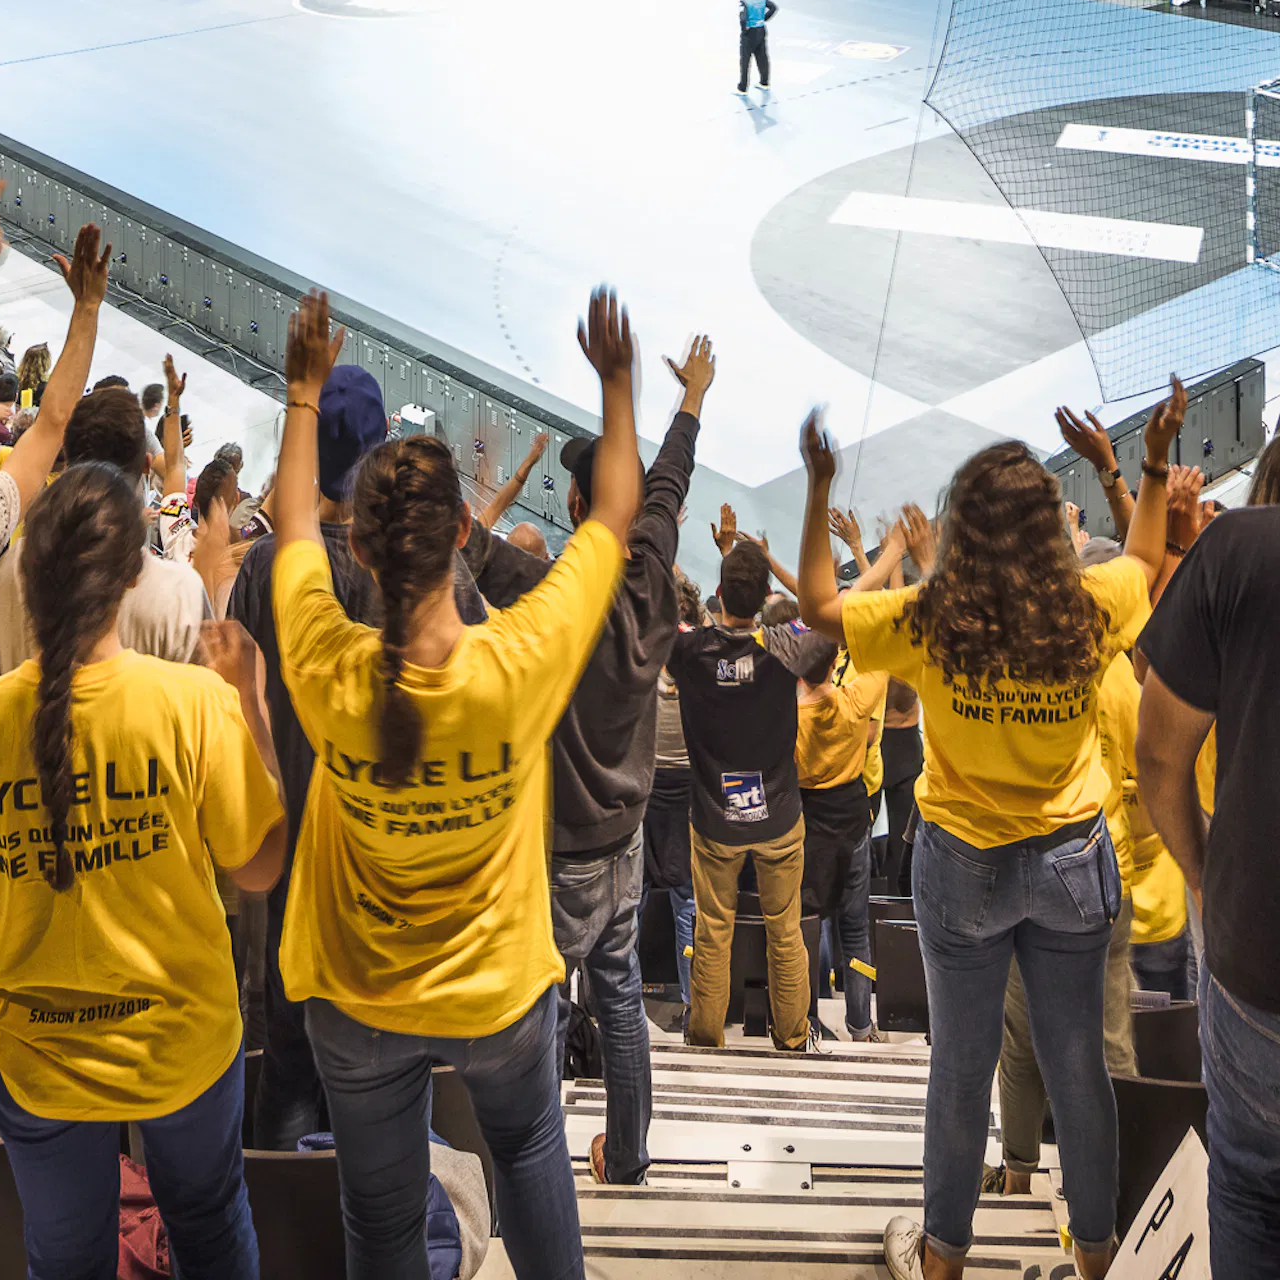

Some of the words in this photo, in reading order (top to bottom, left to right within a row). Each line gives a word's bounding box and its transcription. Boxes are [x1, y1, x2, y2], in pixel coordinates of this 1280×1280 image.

[951, 697, 995, 725] UNE
[1000, 696, 1090, 725] FAMILLE
[106, 758, 169, 801] L.I.
[728, 786, 761, 808] art
[100, 811, 170, 837] LYCÉE,
[386, 795, 516, 837] FAMILLE
[38, 832, 169, 873] FMILLE
[78, 998, 150, 1023] 2017/2018
